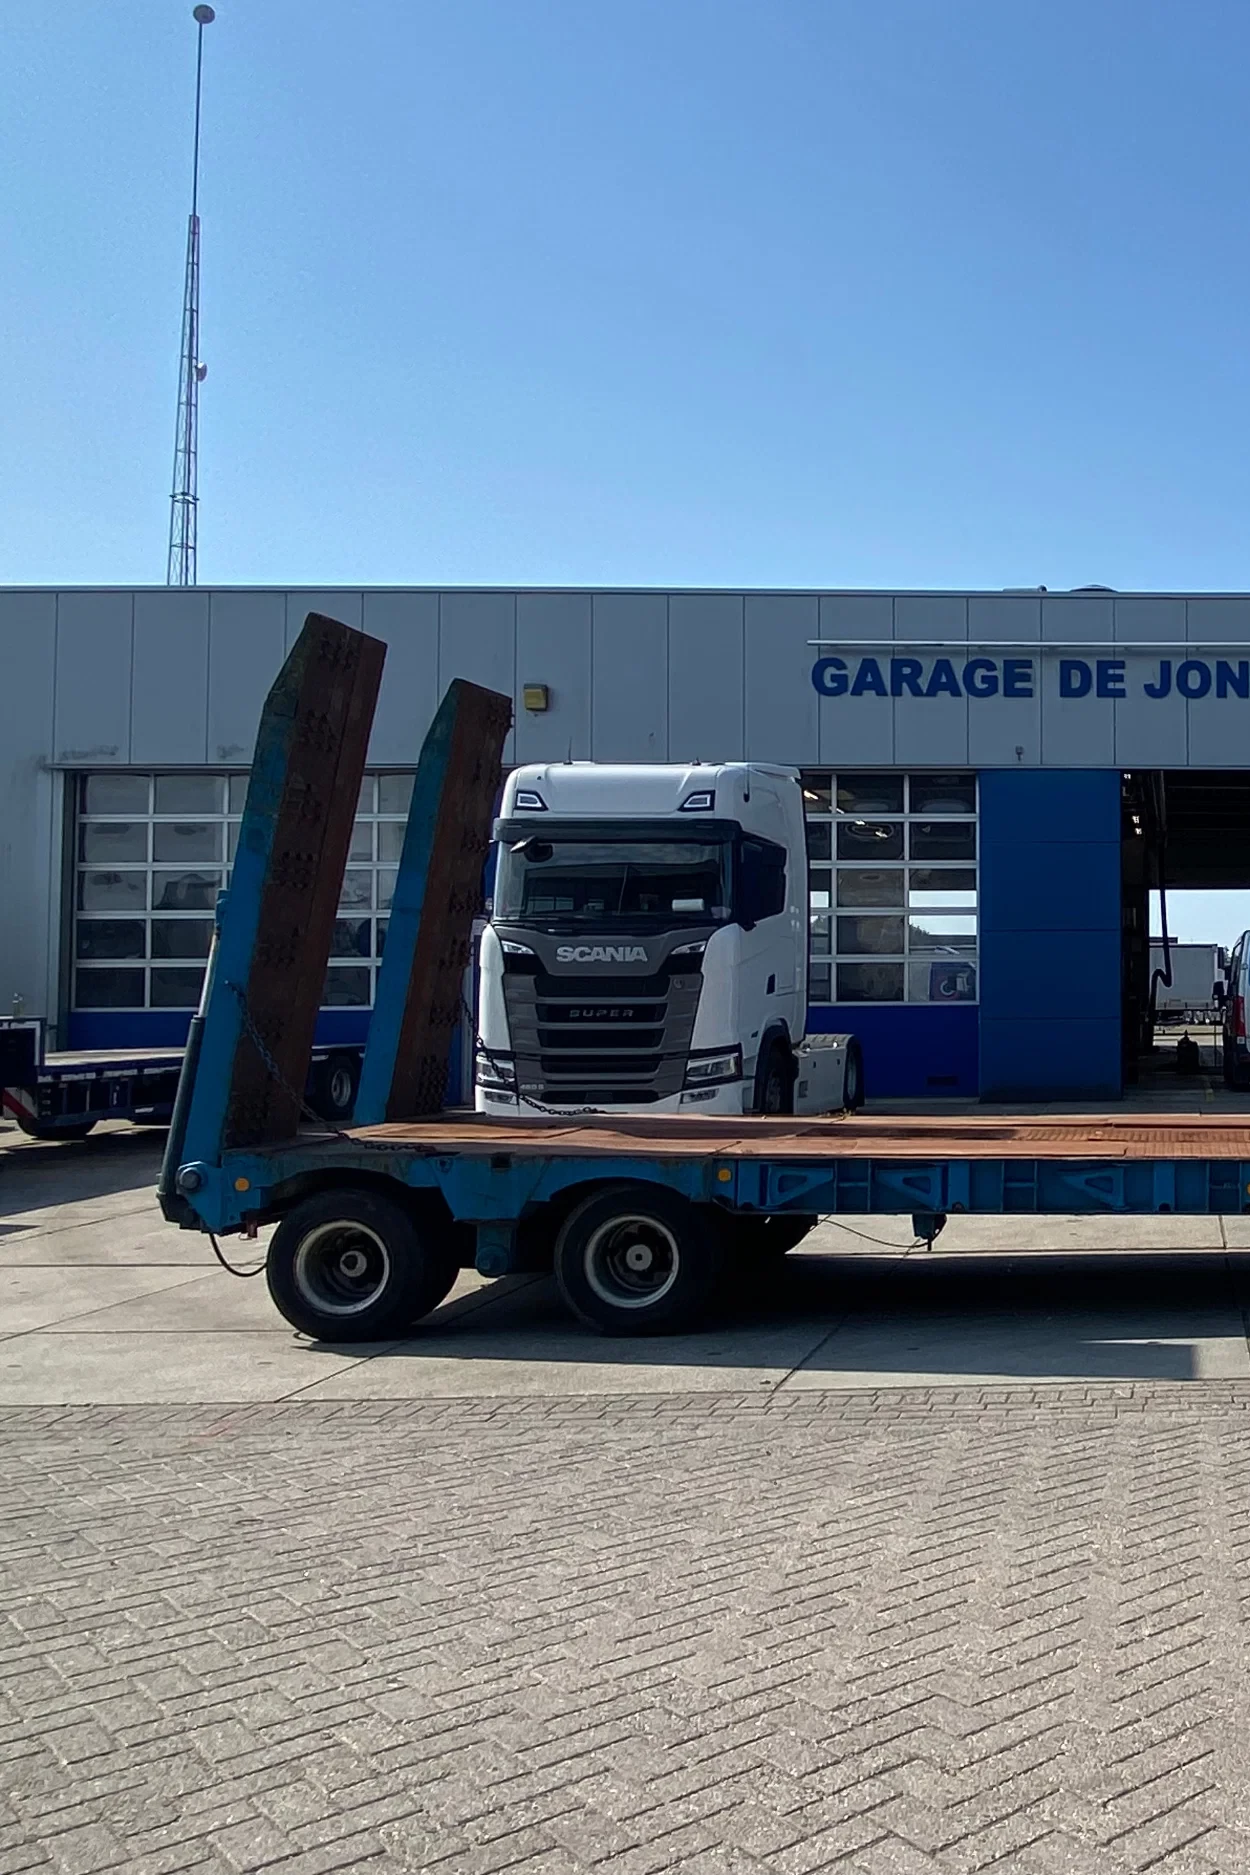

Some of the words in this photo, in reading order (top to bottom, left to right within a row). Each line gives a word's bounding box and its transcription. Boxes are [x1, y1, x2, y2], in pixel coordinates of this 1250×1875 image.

[811, 657, 1034, 698] GARAGE
[1059, 659, 1126, 698] DE
[556, 946, 648, 963] SCANIA
[569, 1009, 634, 1018] SUPER
